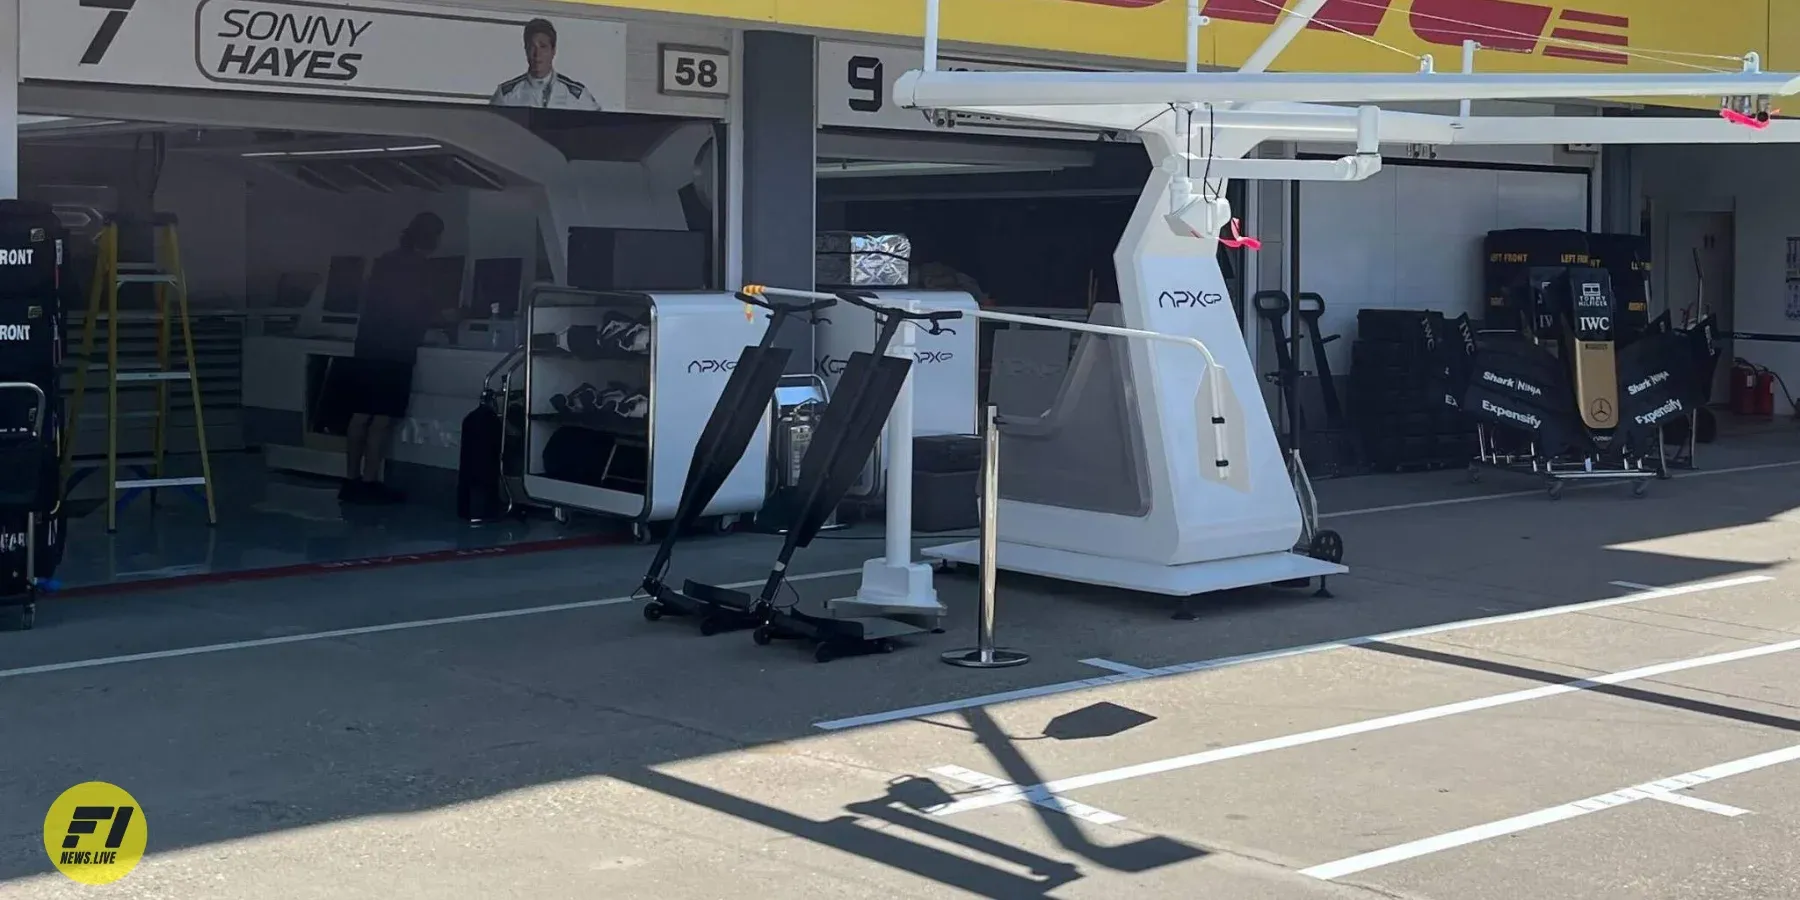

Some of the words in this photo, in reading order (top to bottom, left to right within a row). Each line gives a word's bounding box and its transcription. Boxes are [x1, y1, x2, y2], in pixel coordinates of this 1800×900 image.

[217, 9, 373, 47] SONNY
[217, 44, 364, 81] HAYES
[674, 56, 719, 88] 58
[847, 55, 884, 113] 9
[1580, 316, 1610, 331] IWC
[1482, 370, 1515, 388] Shark
[1627, 377, 1652, 396] Shark
[1481, 399, 1542, 429] Expensify
[1634, 398, 1683, 425] Expensify
